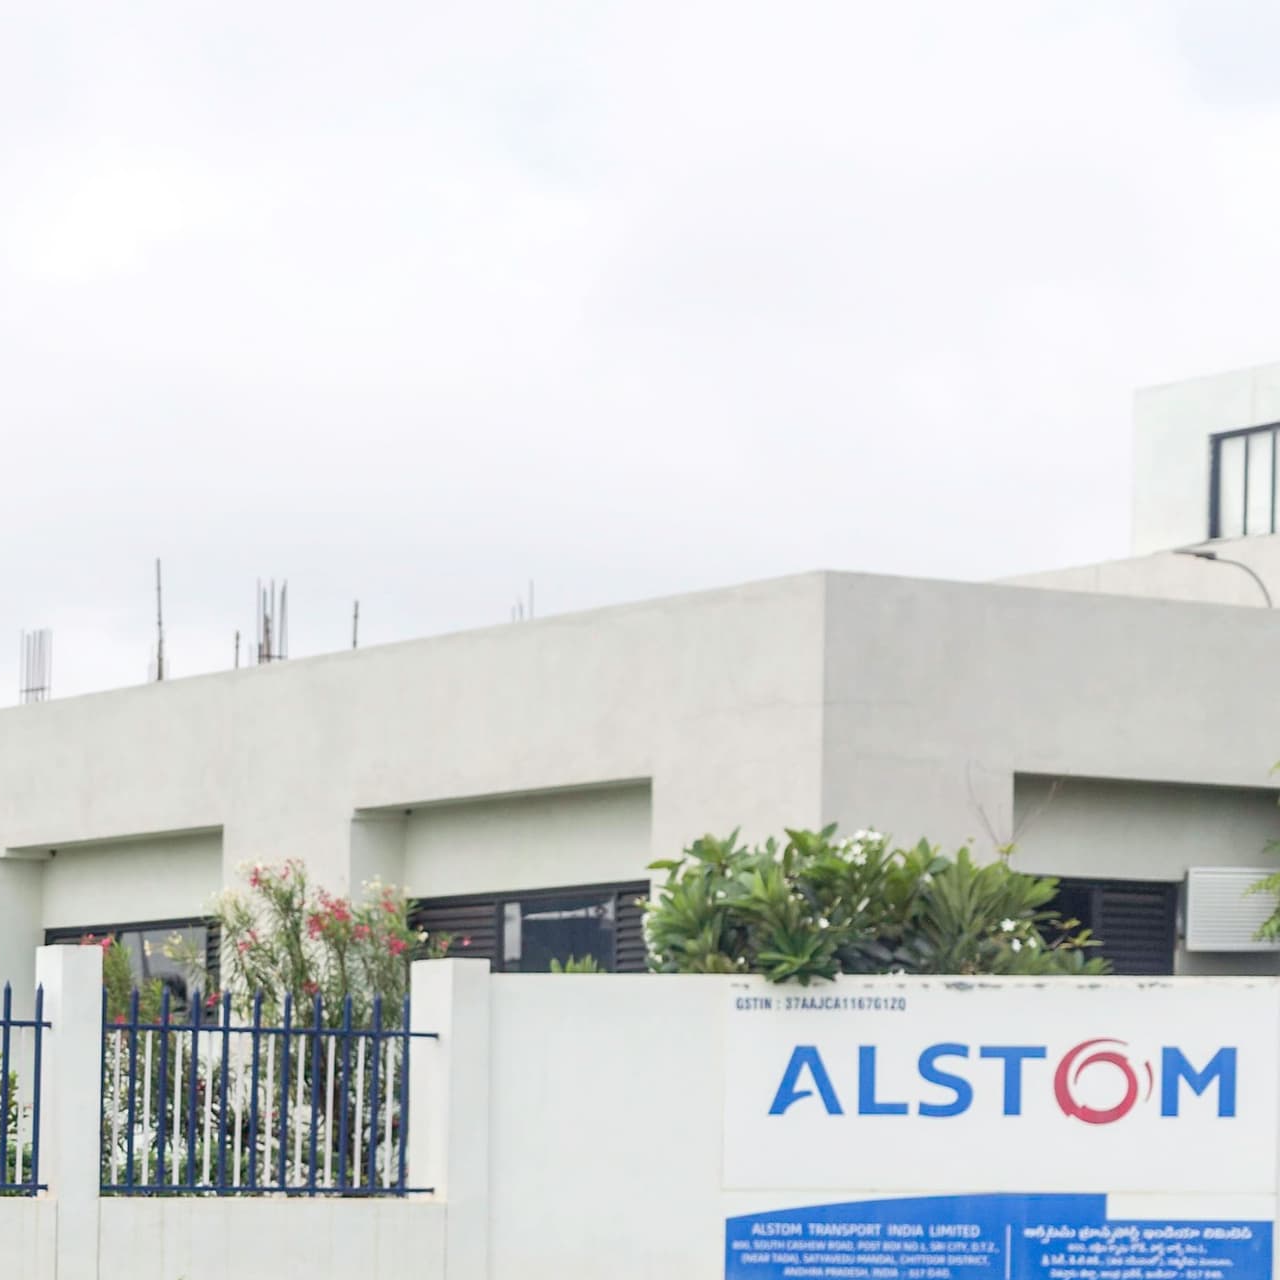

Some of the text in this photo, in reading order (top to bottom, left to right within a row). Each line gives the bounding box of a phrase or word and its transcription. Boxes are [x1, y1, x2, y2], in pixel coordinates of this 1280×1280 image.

[736, 996, 772, 1010] GSTIN
[768, 1038, 1238, 1125] ALSTOM
[751, 1222, 981, 1238] ALSTOM TRANSPORT INDIA LIMITED
[753, 1240, 785, 1251] SOUTH
